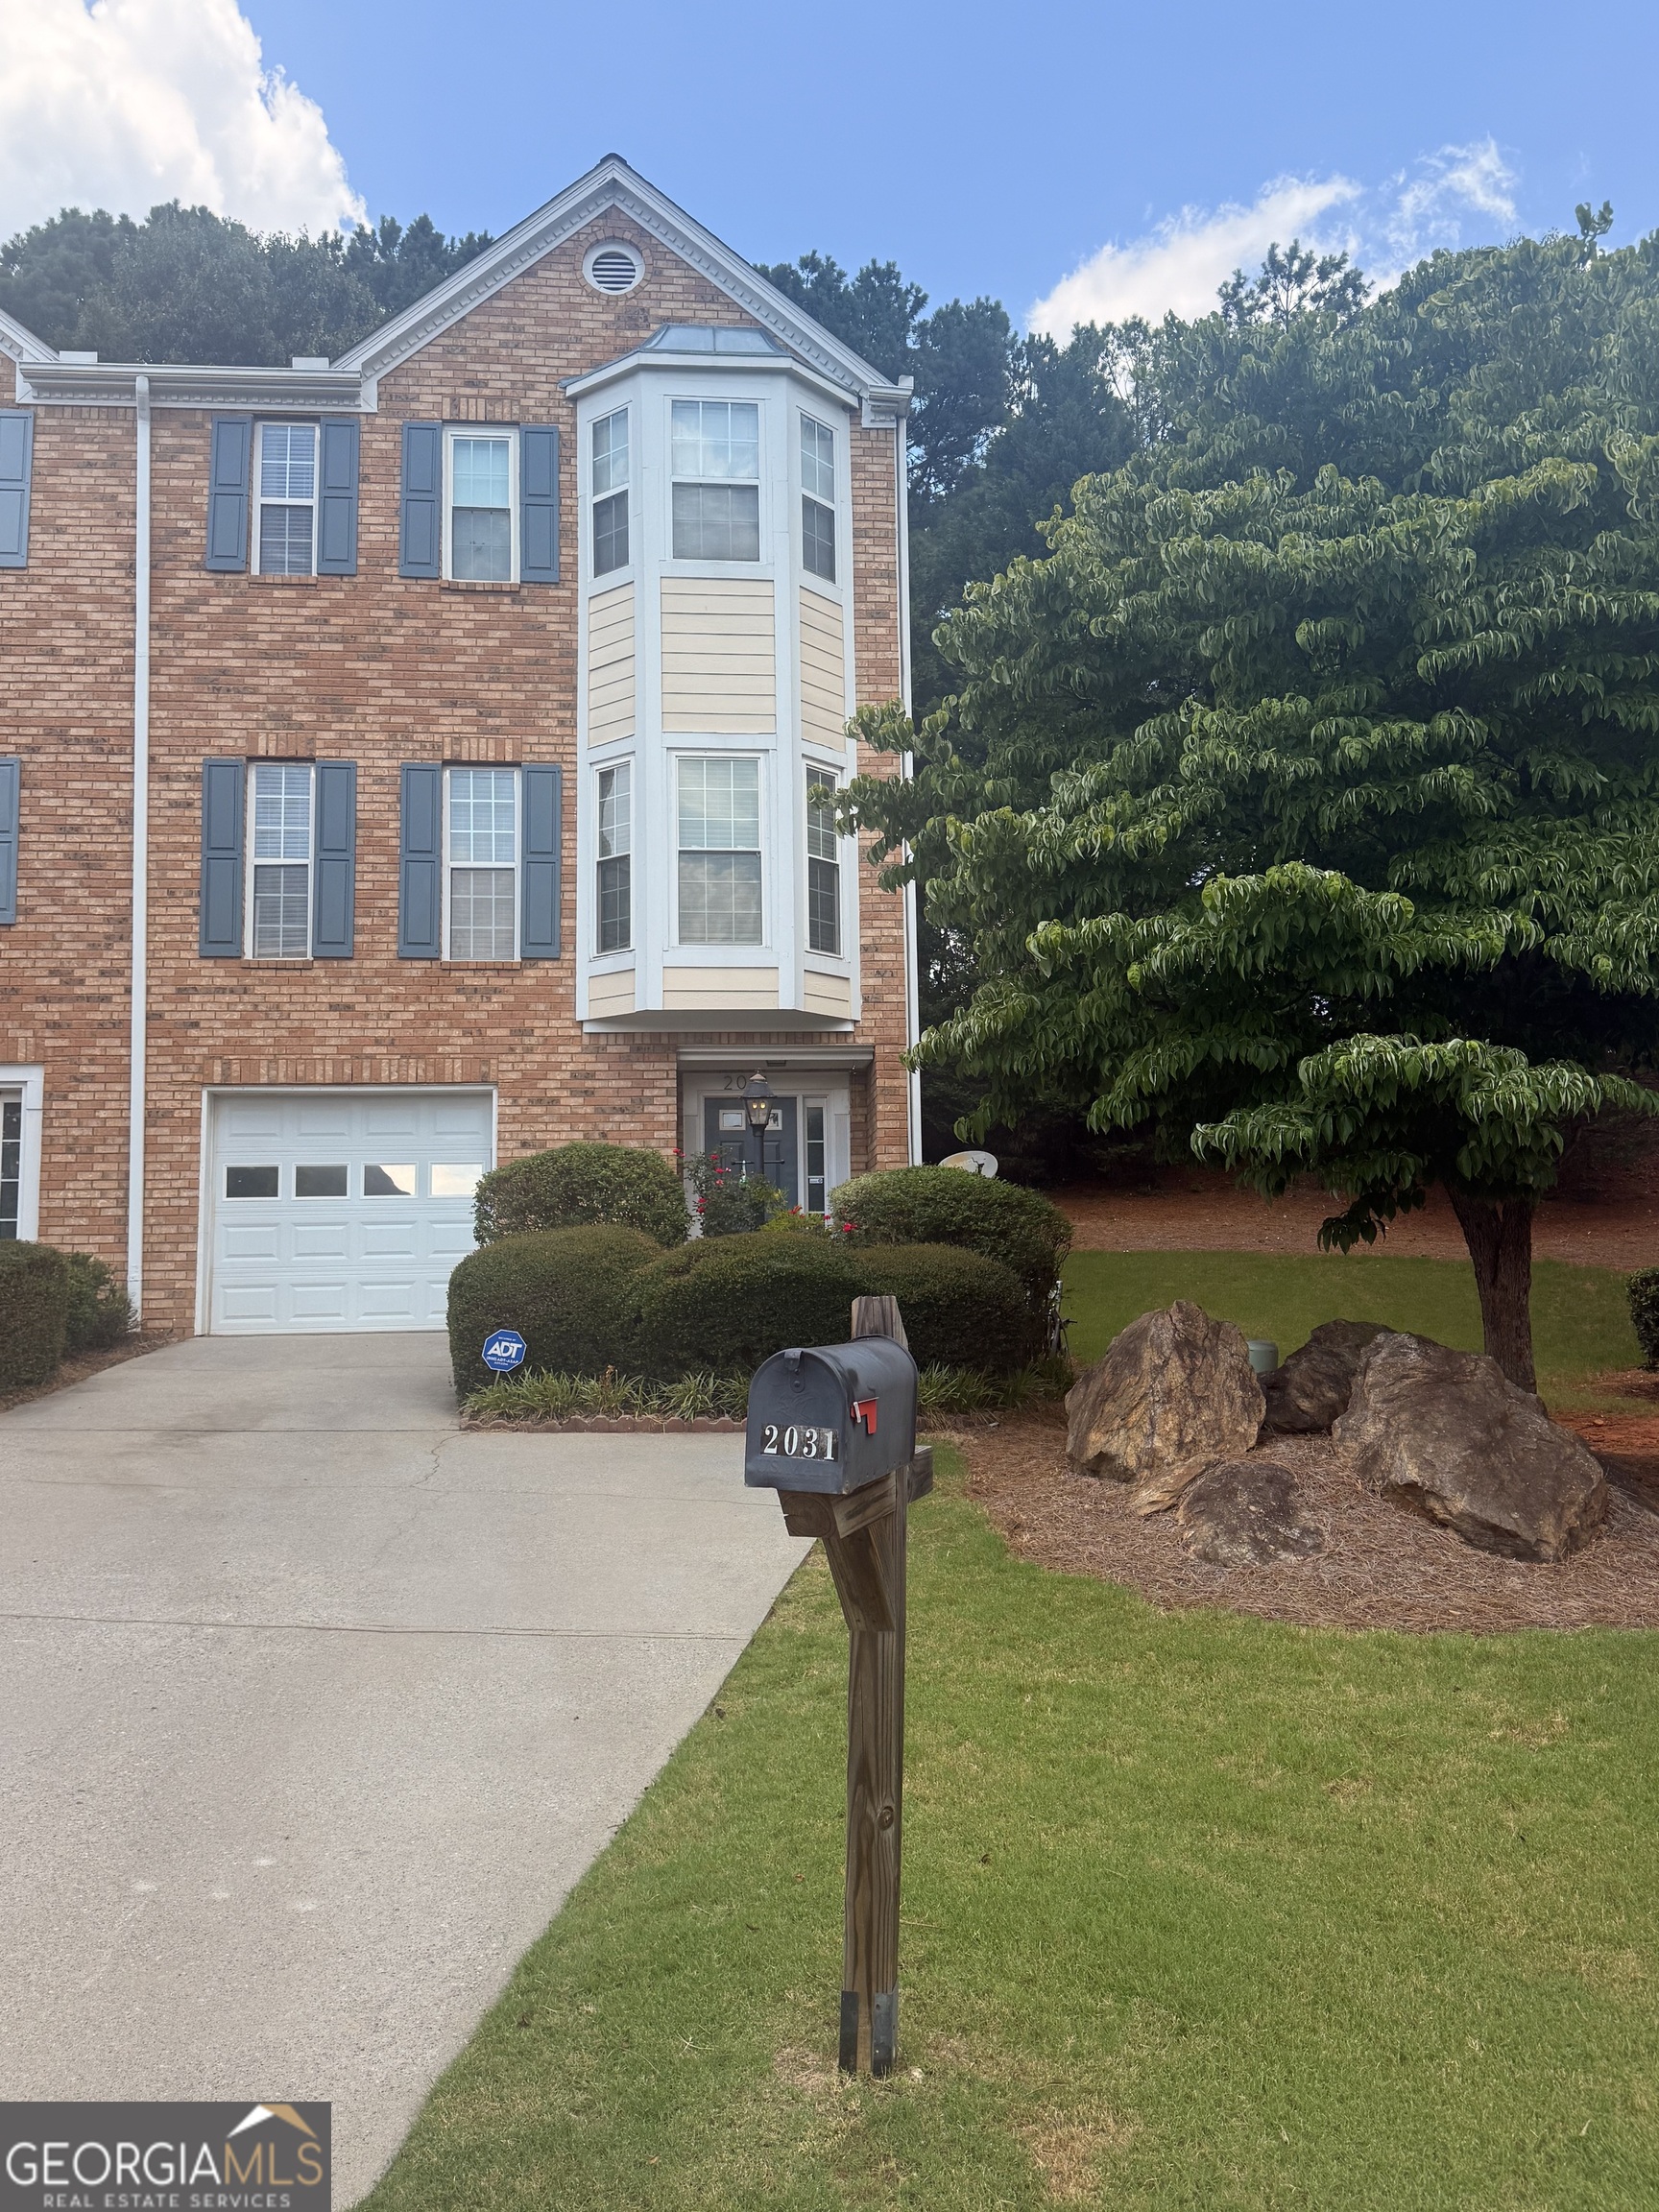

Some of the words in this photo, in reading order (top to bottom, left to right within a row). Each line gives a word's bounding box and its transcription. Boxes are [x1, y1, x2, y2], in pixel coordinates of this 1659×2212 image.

[724, 1075, 747, 1091] 20
[487, 1341, 522, 1358] ADT
[763, 1425, 835, 1460] 2031
